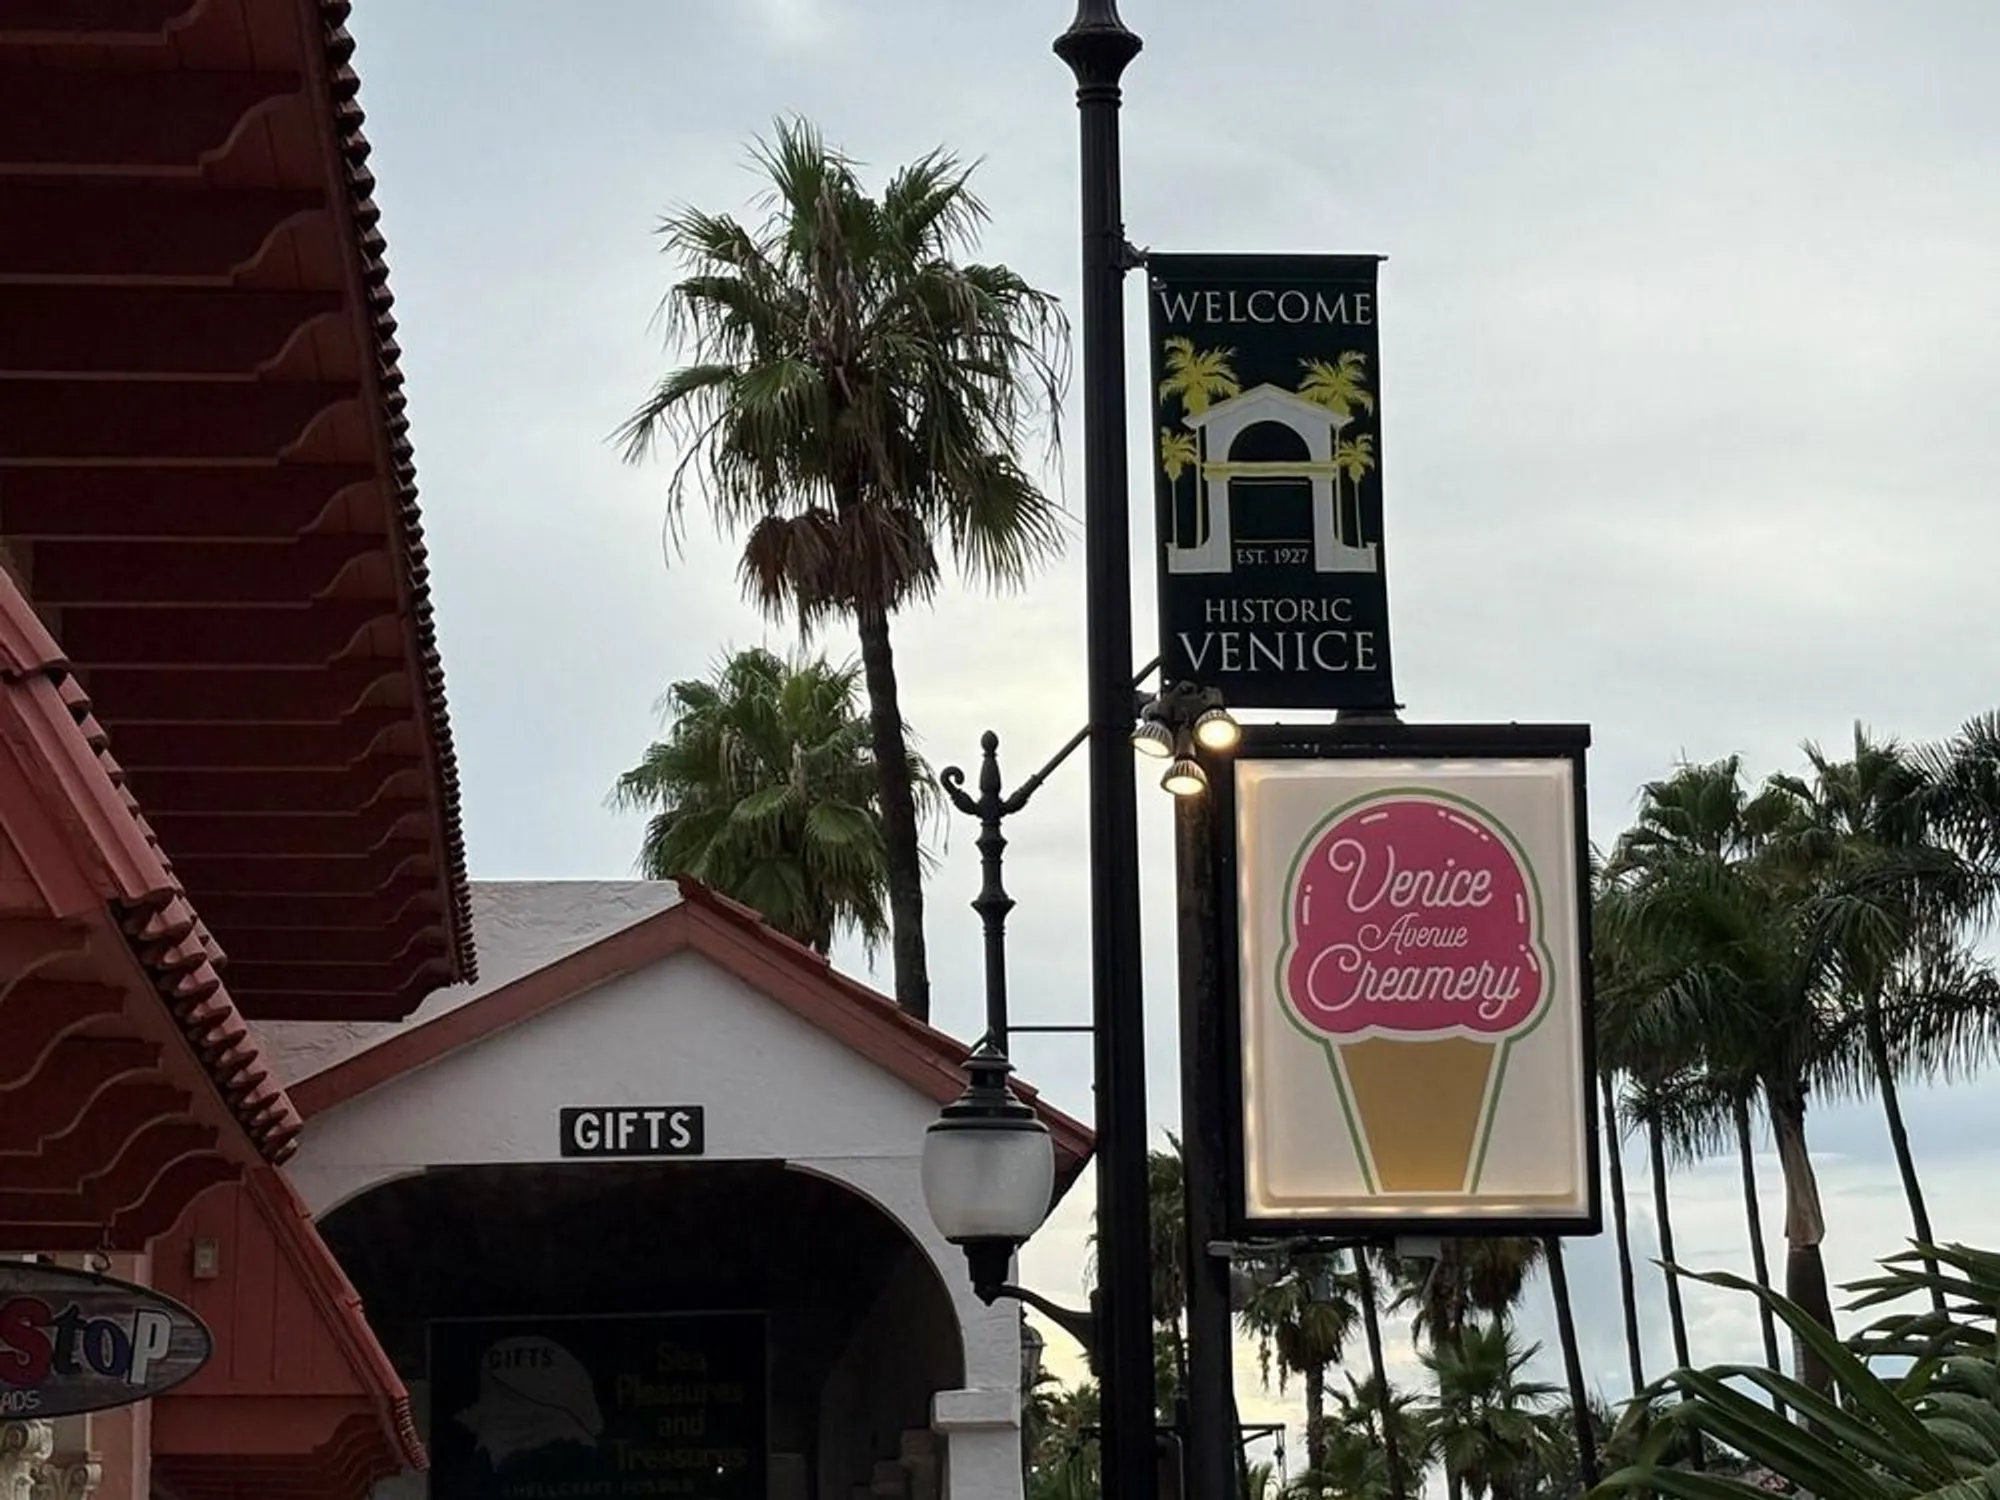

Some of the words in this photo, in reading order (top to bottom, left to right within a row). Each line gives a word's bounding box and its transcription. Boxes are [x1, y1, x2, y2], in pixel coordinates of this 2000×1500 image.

[1159, 289, 1373, 325] WELCOME
[1236, 548, 1268, 564] EST.
[1274, 548, 1309, 564] 1927
[1205, 598, 1353, 623] HISTORIC
[1177, 631, 1378, 673] VENICE
[1328, 837, 1492, 913] Venice
[1358, 911, 1468, 955] Avenue
[1307, 943, 1521, 1020] Creamery
[574, 1111, 692, 1149] GIFTS
[488, 1346, 554, 1371] GIFTS
[657, 1408, 706, 1437] and
